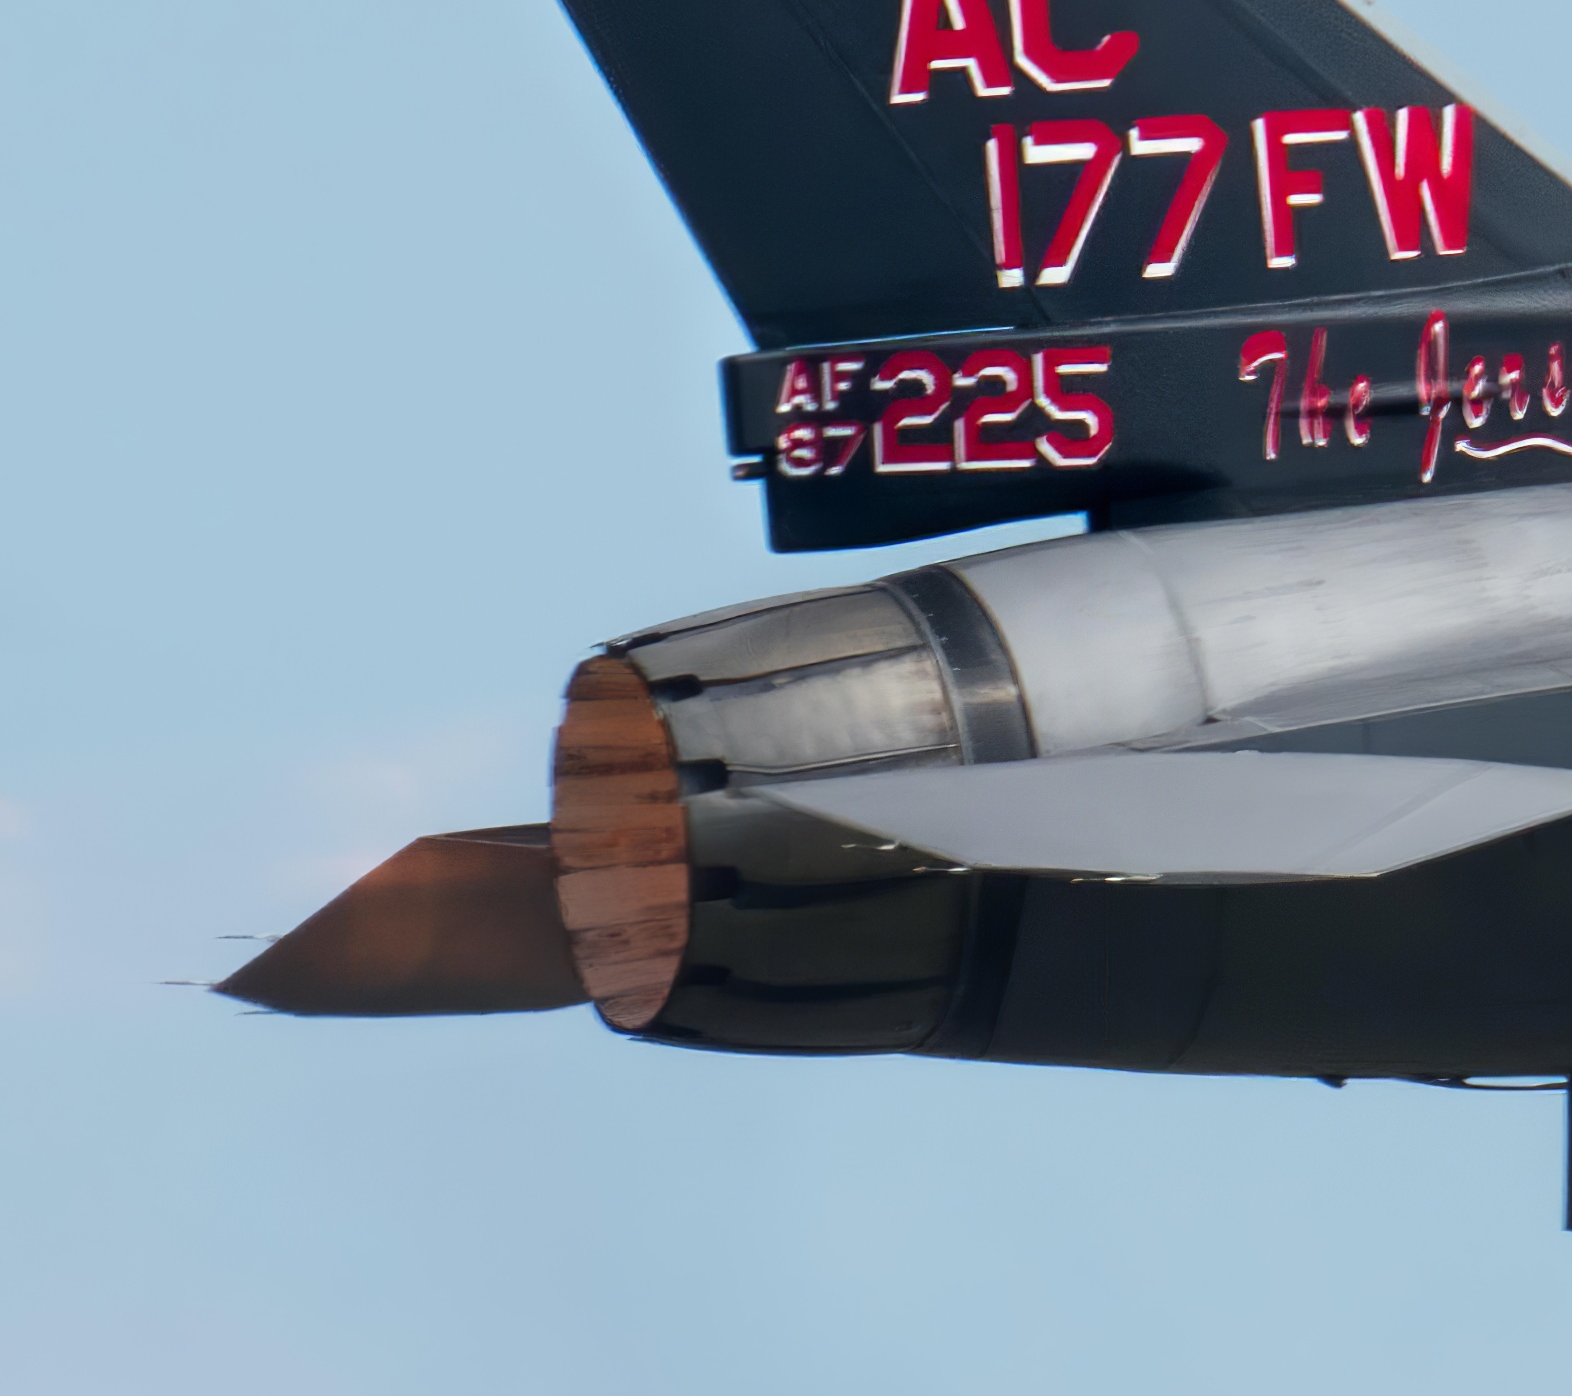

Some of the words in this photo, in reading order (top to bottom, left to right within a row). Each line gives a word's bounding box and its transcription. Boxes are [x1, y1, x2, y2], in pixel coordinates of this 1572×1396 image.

[775, 355, 866, 414] AF
[871, 347, 1115, 473] 225
[1239, 327, 1372, 460] The
[775, 421, 867, 477] 87
